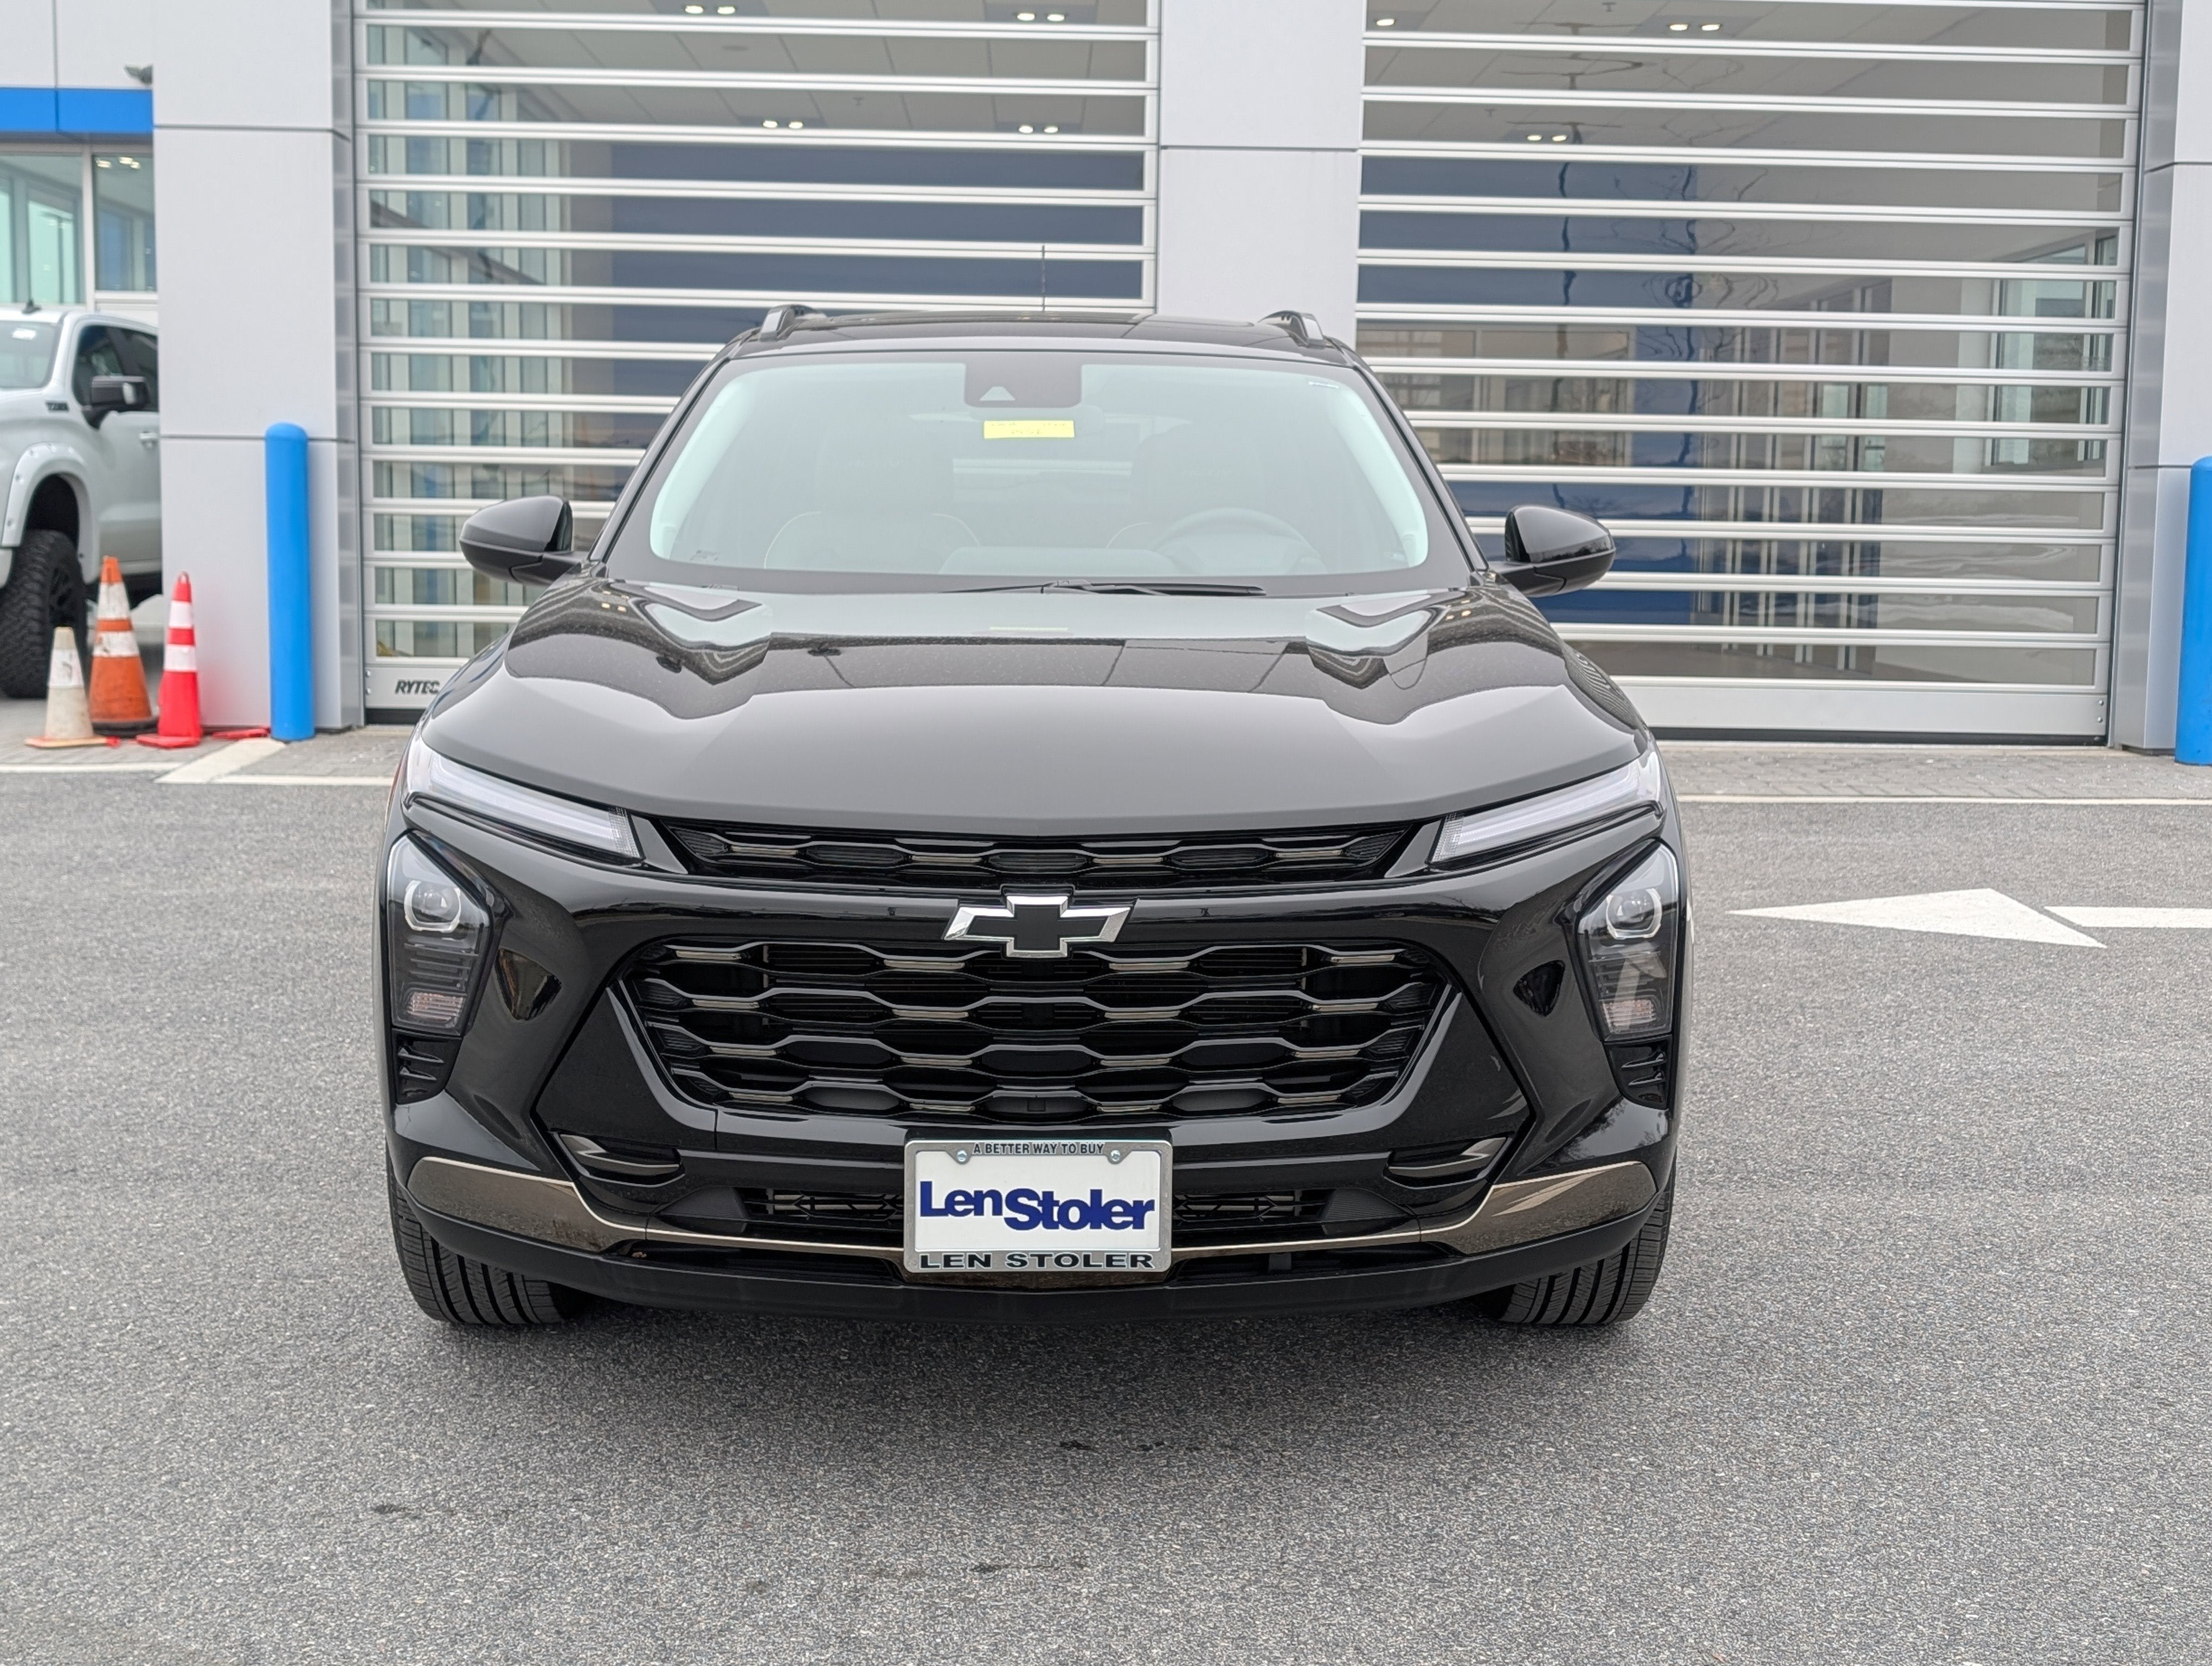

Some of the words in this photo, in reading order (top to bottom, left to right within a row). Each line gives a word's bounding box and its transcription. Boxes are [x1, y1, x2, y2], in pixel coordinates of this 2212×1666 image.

[395, 679, 440, 694] RYTEC
[973, 1143, 981, 1154] A
[985, 1143, 1030, 1154] BETTER
[1033, 1143, 1058, 1154] WAY
[1061, 1143, 1077, 1154] TO
[1081, 1143, 1104, 1154] BUY
[919, 1253, 992, 1269] LEN
[1005, 1253, 1154, 1269] STOLER
